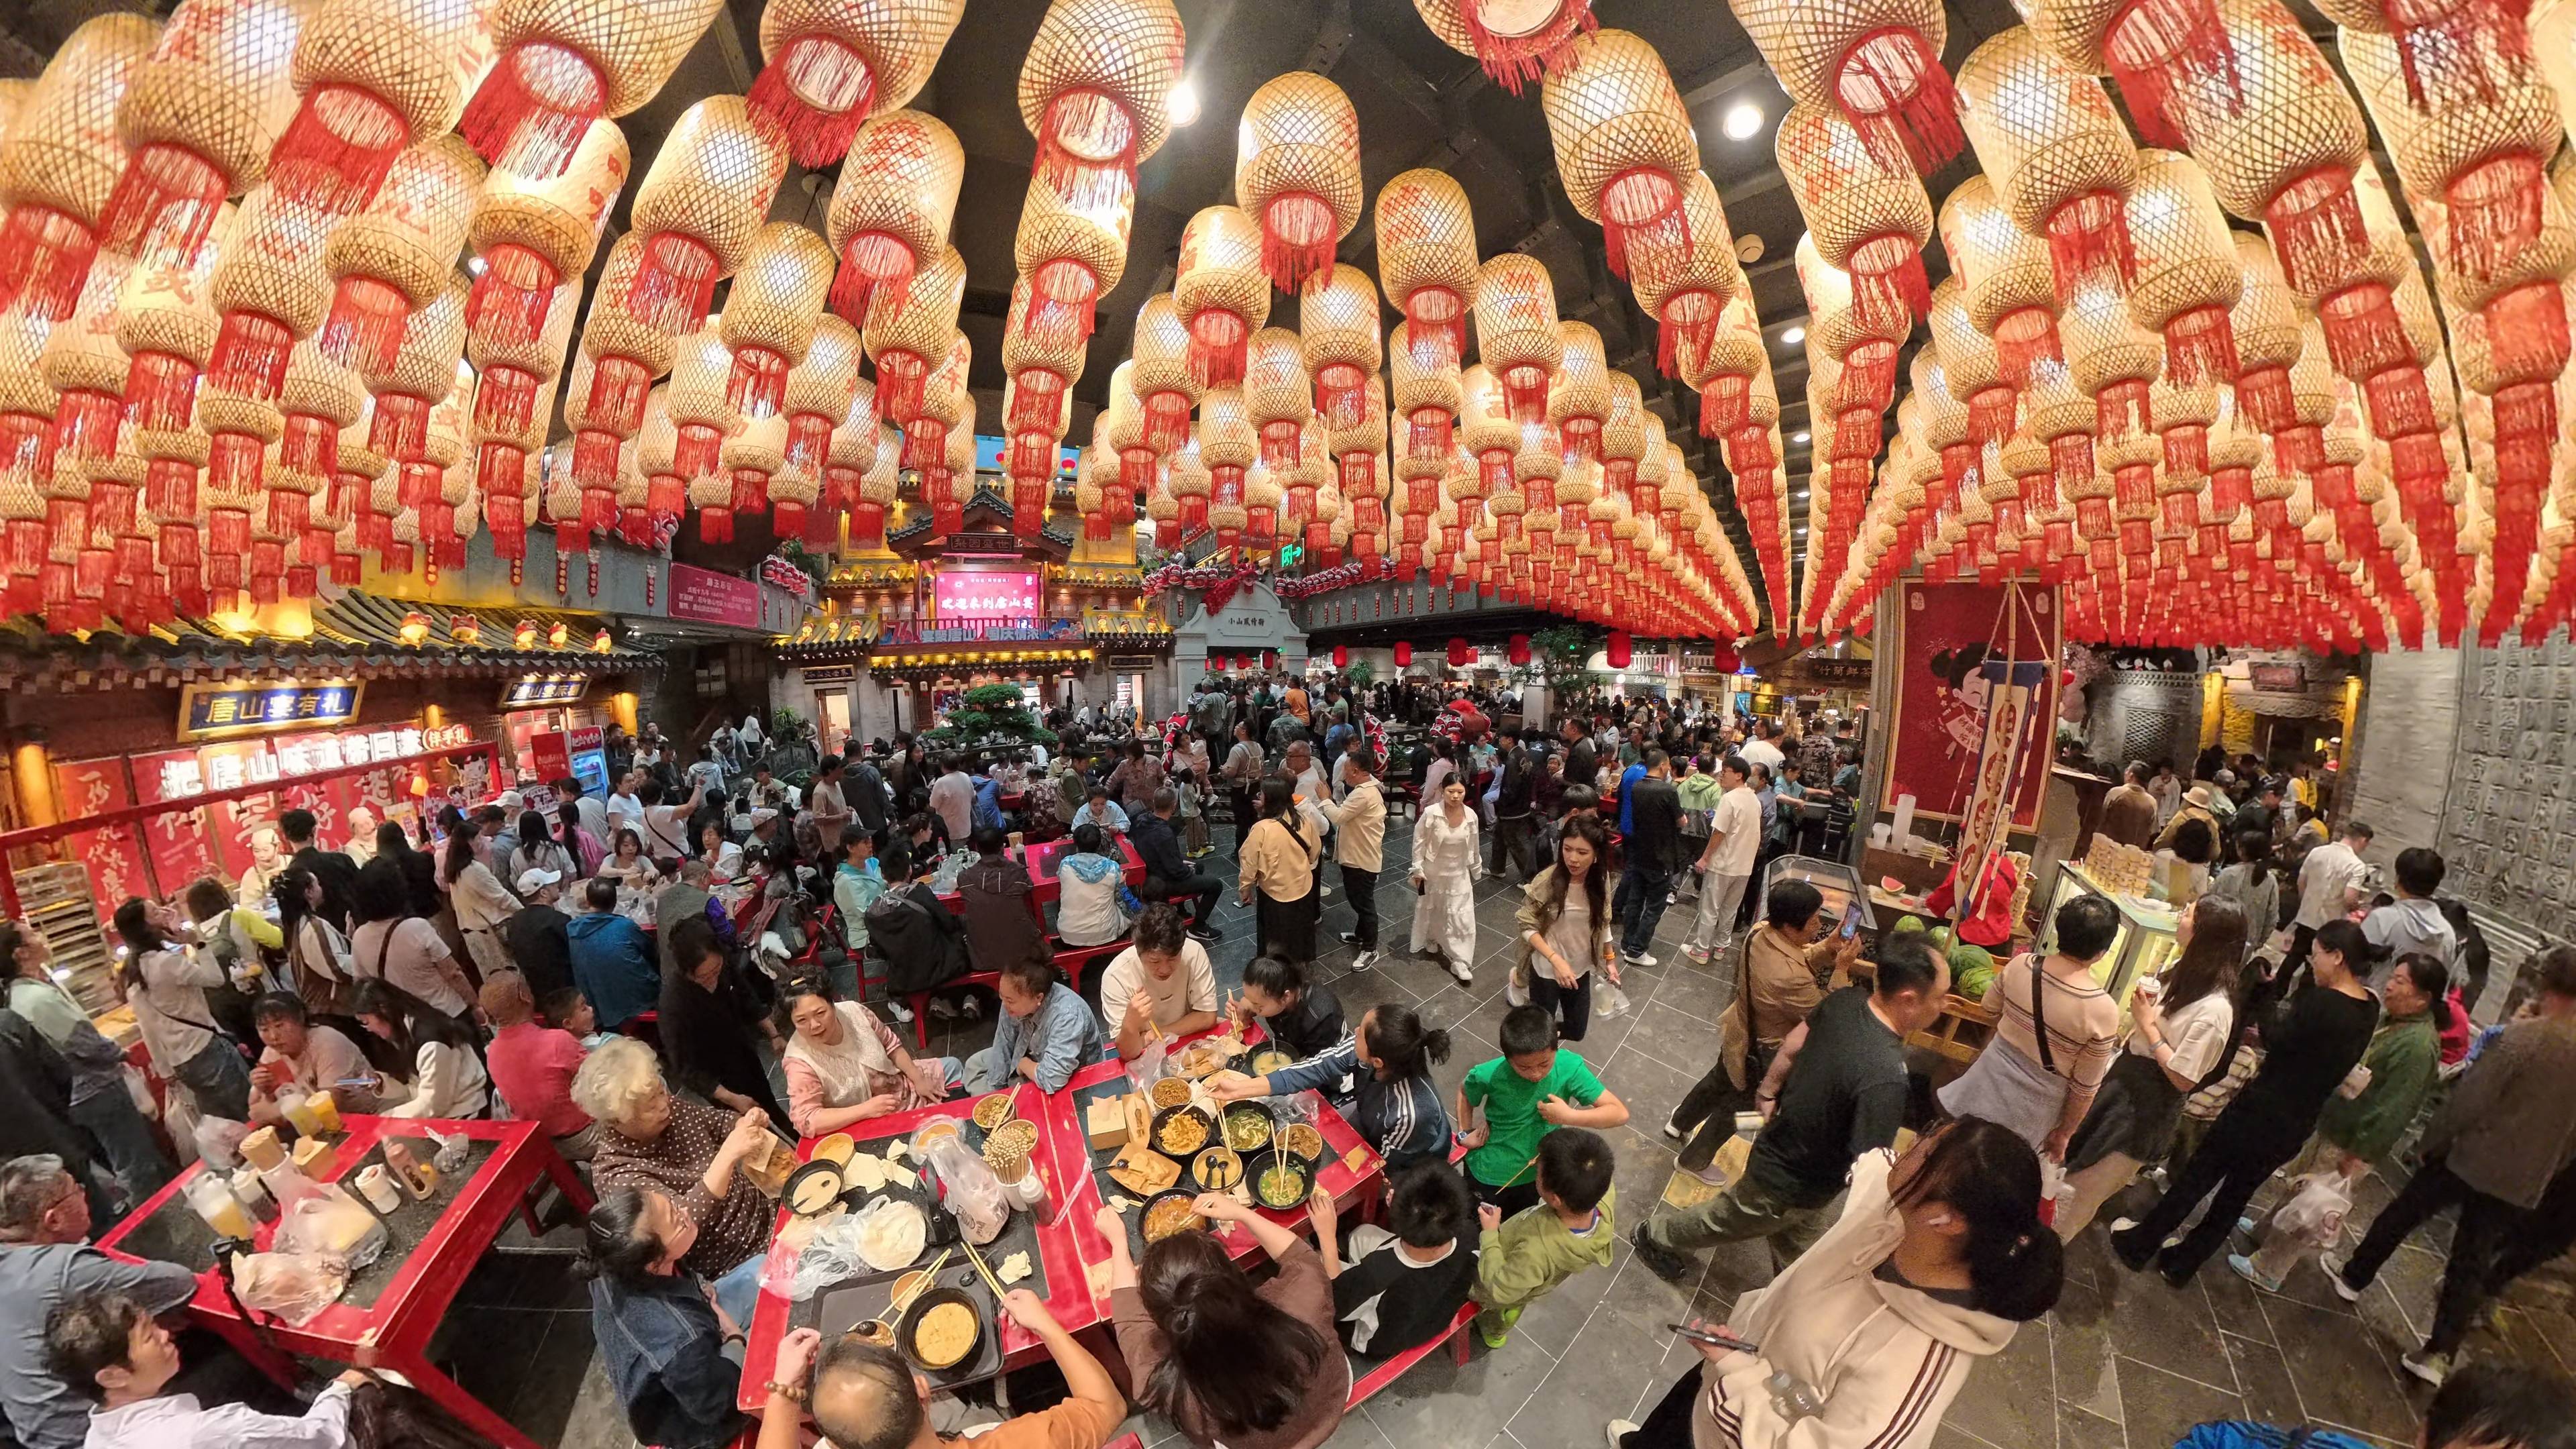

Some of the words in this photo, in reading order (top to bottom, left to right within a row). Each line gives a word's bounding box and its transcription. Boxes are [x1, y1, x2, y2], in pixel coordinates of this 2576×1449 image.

[941, 596, 1034, 610] 欢迎来到唐山宴
[206, 693, 345, 722] 唐山宴有礼
[160, 728, 422, 800] 把唐山味道带回家
[427, 727, 469, 747] 伴手礼
